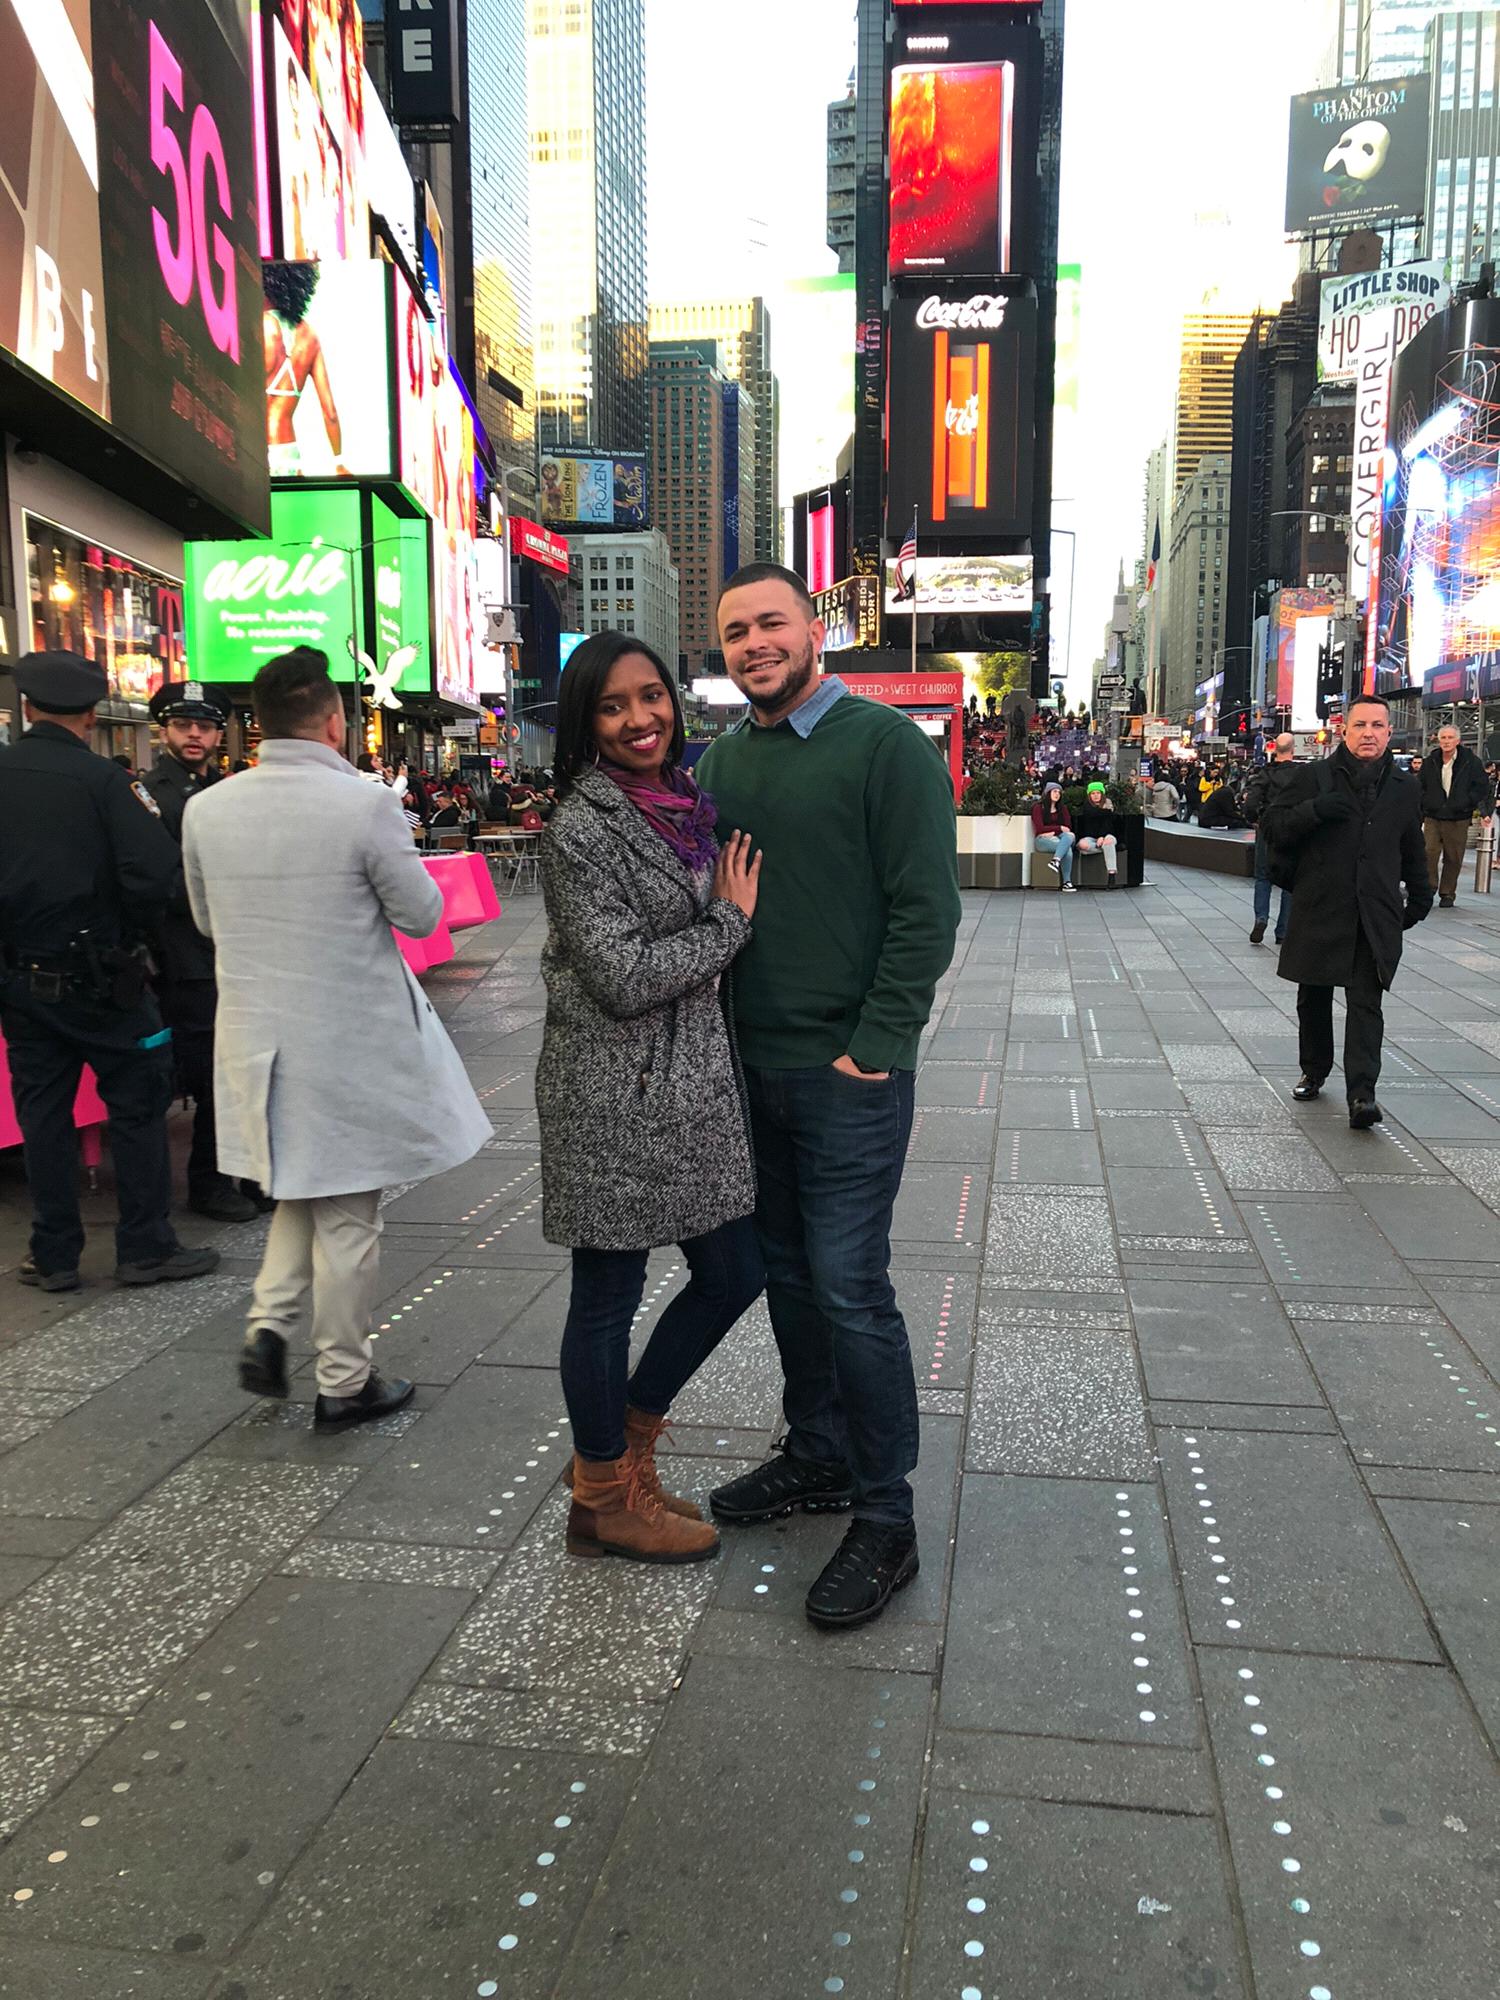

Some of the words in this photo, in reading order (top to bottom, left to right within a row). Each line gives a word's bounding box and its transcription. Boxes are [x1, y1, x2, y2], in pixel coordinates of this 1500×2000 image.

[399, 0, 433, 72] E
[1312, 89, 1406, 118] PHANTOM
[1349, 87, 1369, 98] THE
[1320, 113, 1335, 125] OF
[1338, 109, 1359, 122] THE
[1361, 104, 1397, 118] OPERA
[149, 19, 240, 366] 5G
[1333, 272, 1393, 314] LITTLE
[1396, 271, 1440, 298] SHOP
[1324, 369, 1355, 379] Westside
[593, 447, 611, 457] Disney
[1353, 331, 1389, 568] COVERGIRL
[562, 461, 573, 481] KING
[562, 482, 573, 502] LION
[592, 462, 609, 519] FROZEN
[625, 465, 643, 521] Aladdin
[203, 536, 348, 602] aerie
[816, 587, 845, 614] WEST
[859, 578, 868, 608] SIDE
[818, 605, 844, 630] IDE
[859, 609, 868, 641] WEST
[867, 589, 876, 632] STORY
[826, 624, 848, 648] ORY
[890, 683, 917, 695] SWEET
[919, 682, 958, 695] CHURROS
